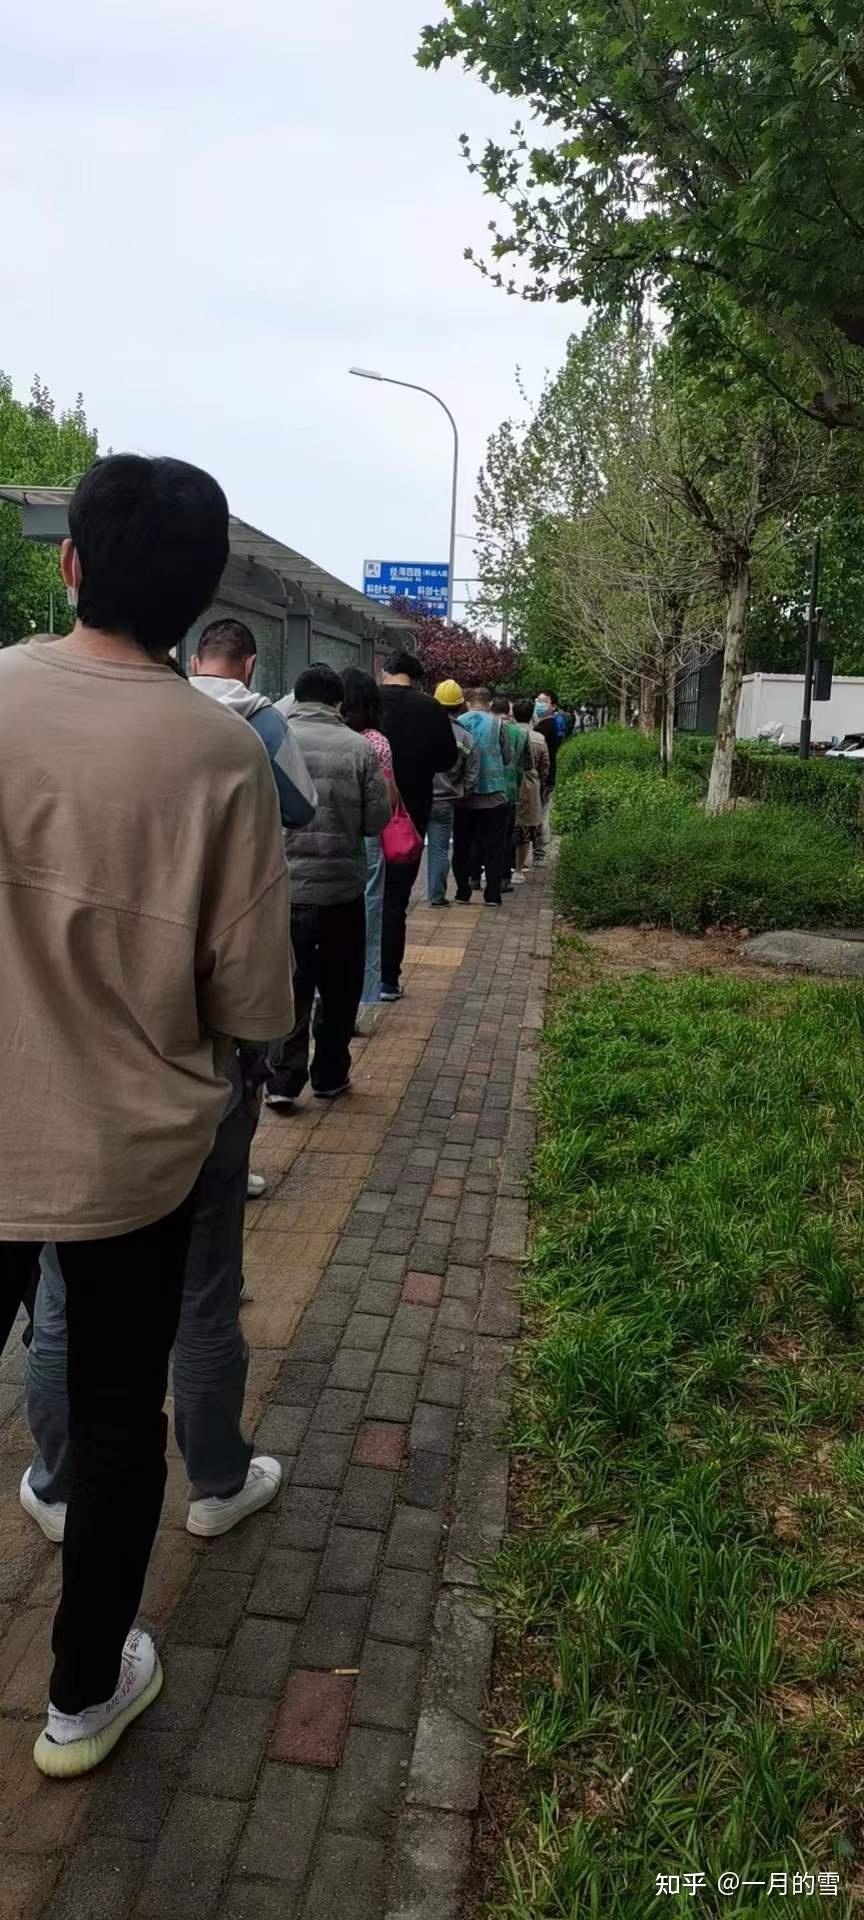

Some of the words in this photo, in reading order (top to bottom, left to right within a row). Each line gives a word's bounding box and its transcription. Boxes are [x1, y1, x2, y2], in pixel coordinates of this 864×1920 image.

[366, 584, 396, 595] 科创七街
[417, 586, 448, 596] 科创七街
